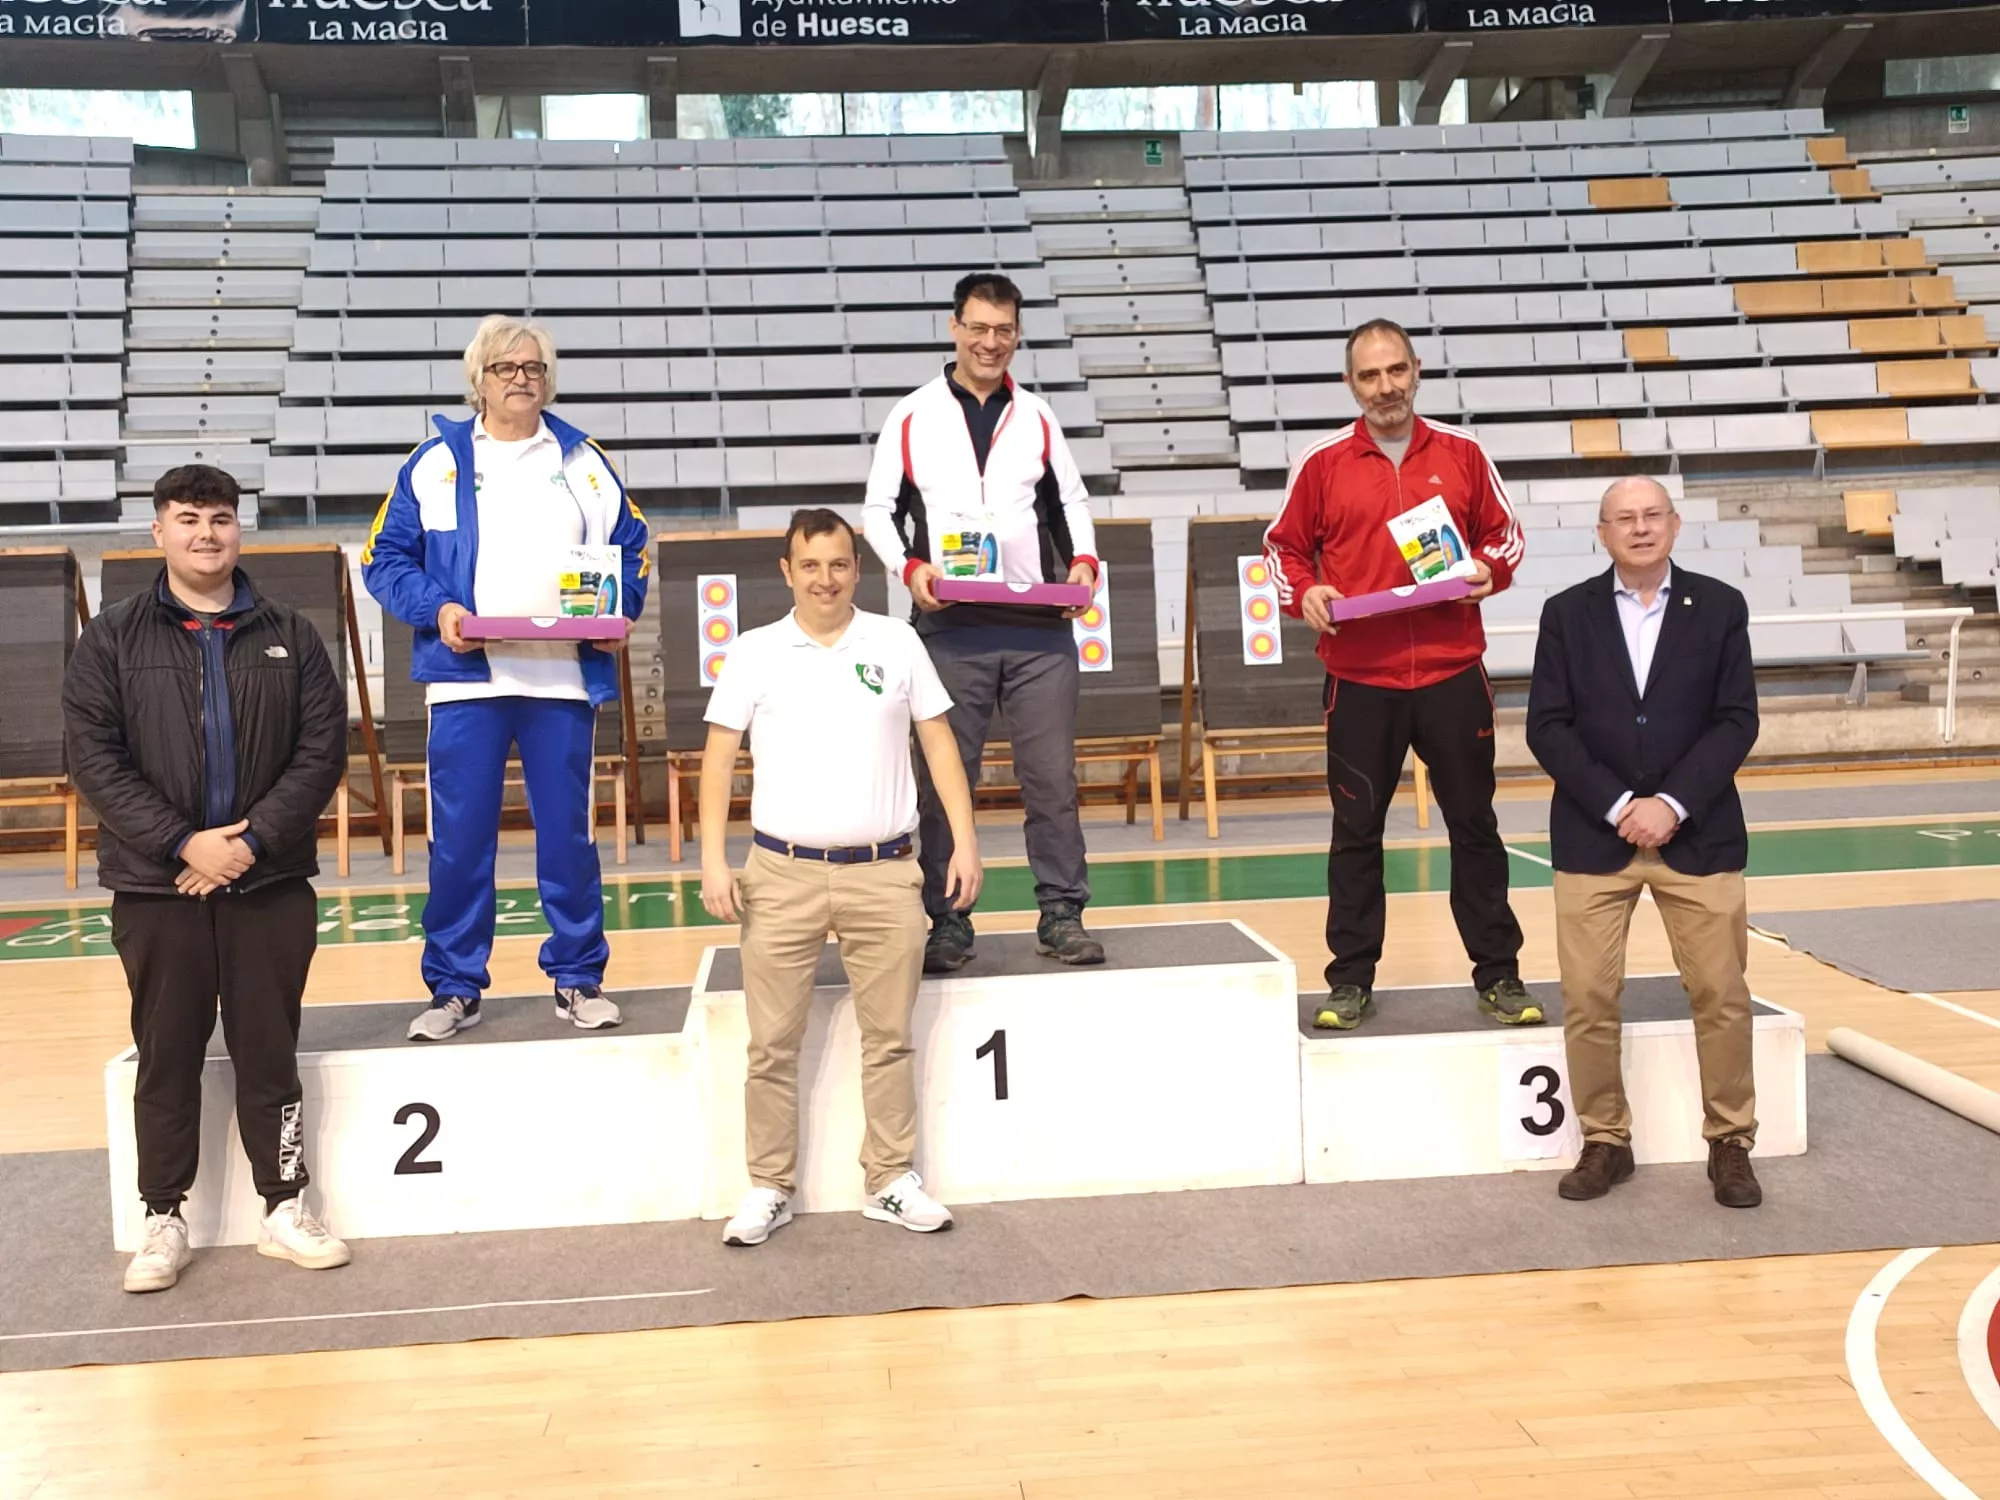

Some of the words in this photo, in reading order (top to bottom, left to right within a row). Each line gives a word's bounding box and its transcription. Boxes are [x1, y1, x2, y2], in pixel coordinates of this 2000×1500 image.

[752, 13, 787, 37] de
[797, 12, 909, 37] Huesca
[976, 1029, 1008, 1100] 1
[1519, 1065, 1565, 1136] 3
[393, 1102, 442, 1174] 2
